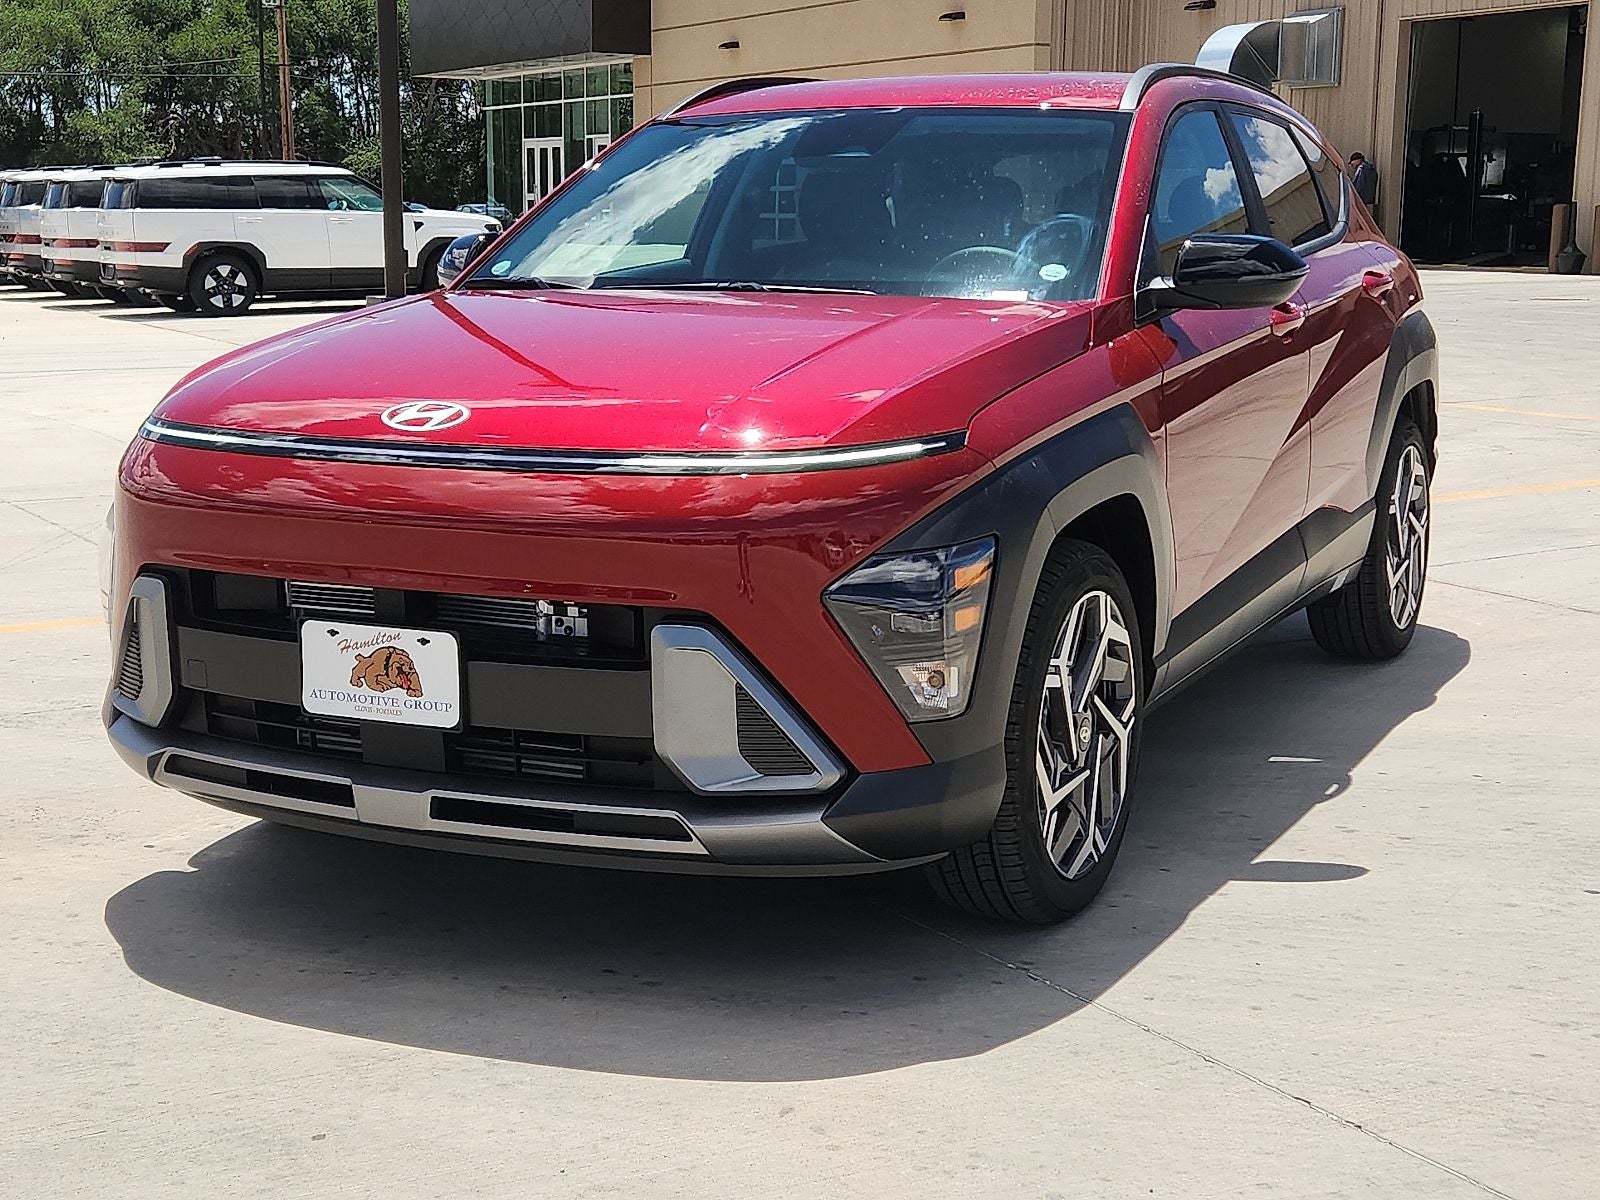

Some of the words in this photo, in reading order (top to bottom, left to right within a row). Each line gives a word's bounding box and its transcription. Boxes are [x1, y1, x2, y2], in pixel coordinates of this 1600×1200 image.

[337, 631, 402, 654] Hamilton
[309, 689, 400, 708] AUTOMOTIVE
[403, 698, 453, 713] GROUP
